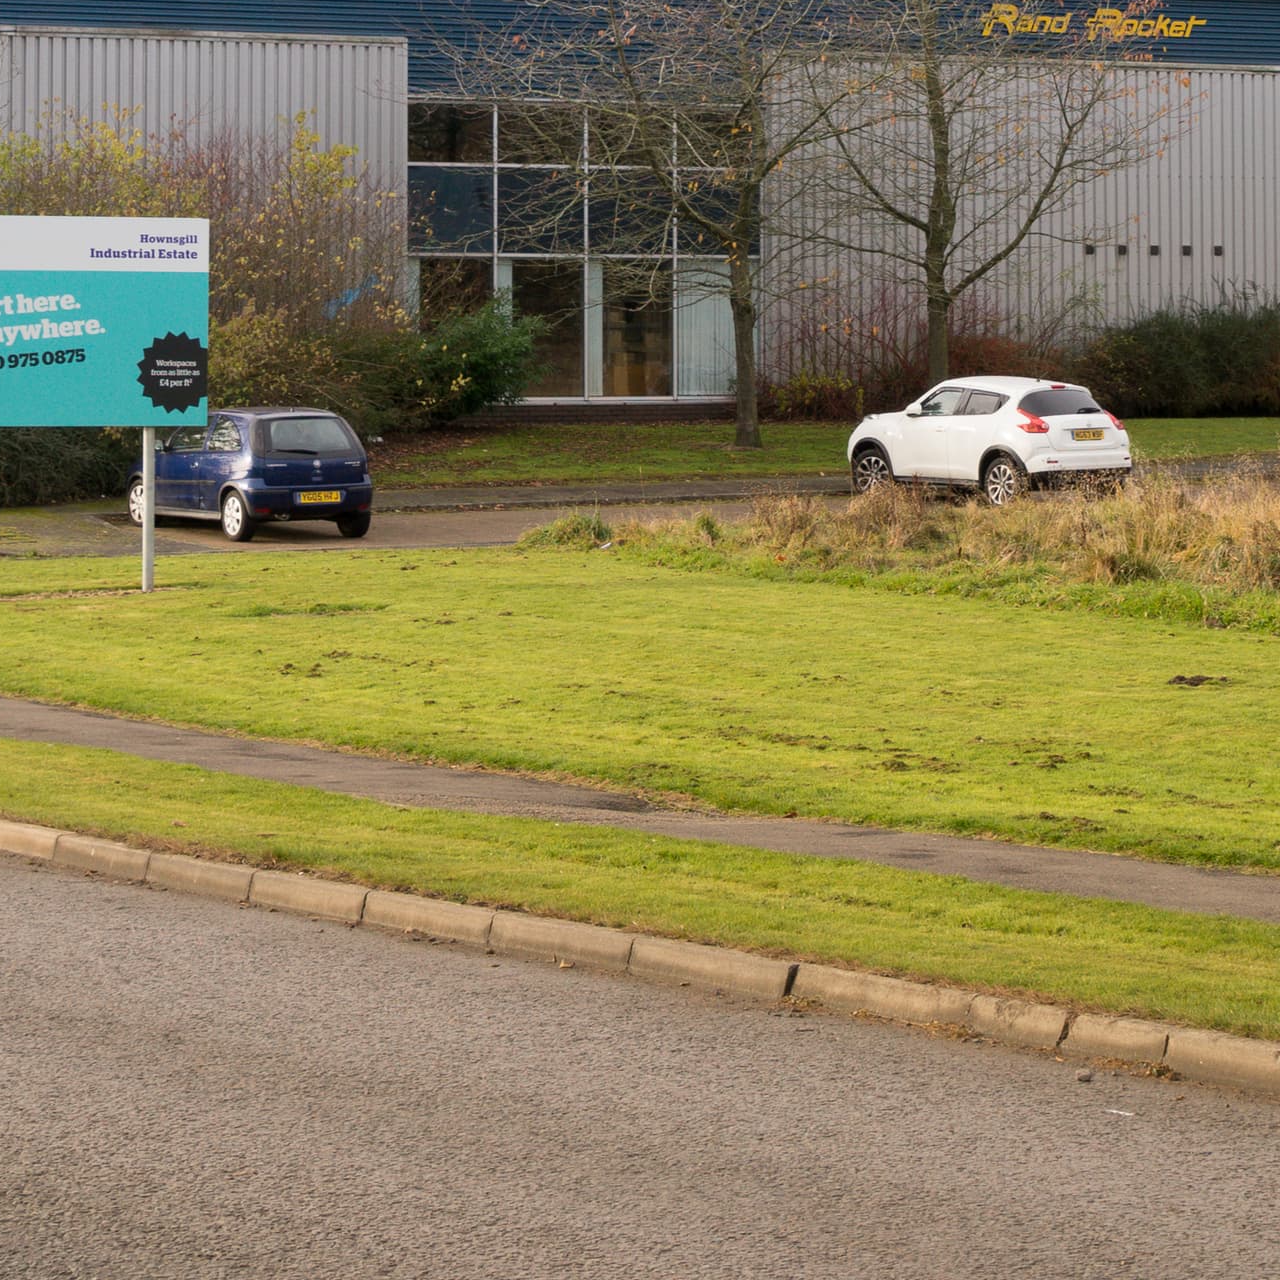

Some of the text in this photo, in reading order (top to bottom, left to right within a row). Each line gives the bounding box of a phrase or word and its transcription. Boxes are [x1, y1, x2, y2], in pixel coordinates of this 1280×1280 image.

[980, 3, 1207, 41] Rand Rocket
[140, 234, 198, 245] Hownsgill
[90, 248, 198, 259] Industrial Estate
[16, 293, 81, 314] here.
[7, 352, 39, 368] 975
[42, 348, 86, 365] 0875
[156, 359, 197, 367] Workspaces
[170, 380, 183, 388] per
